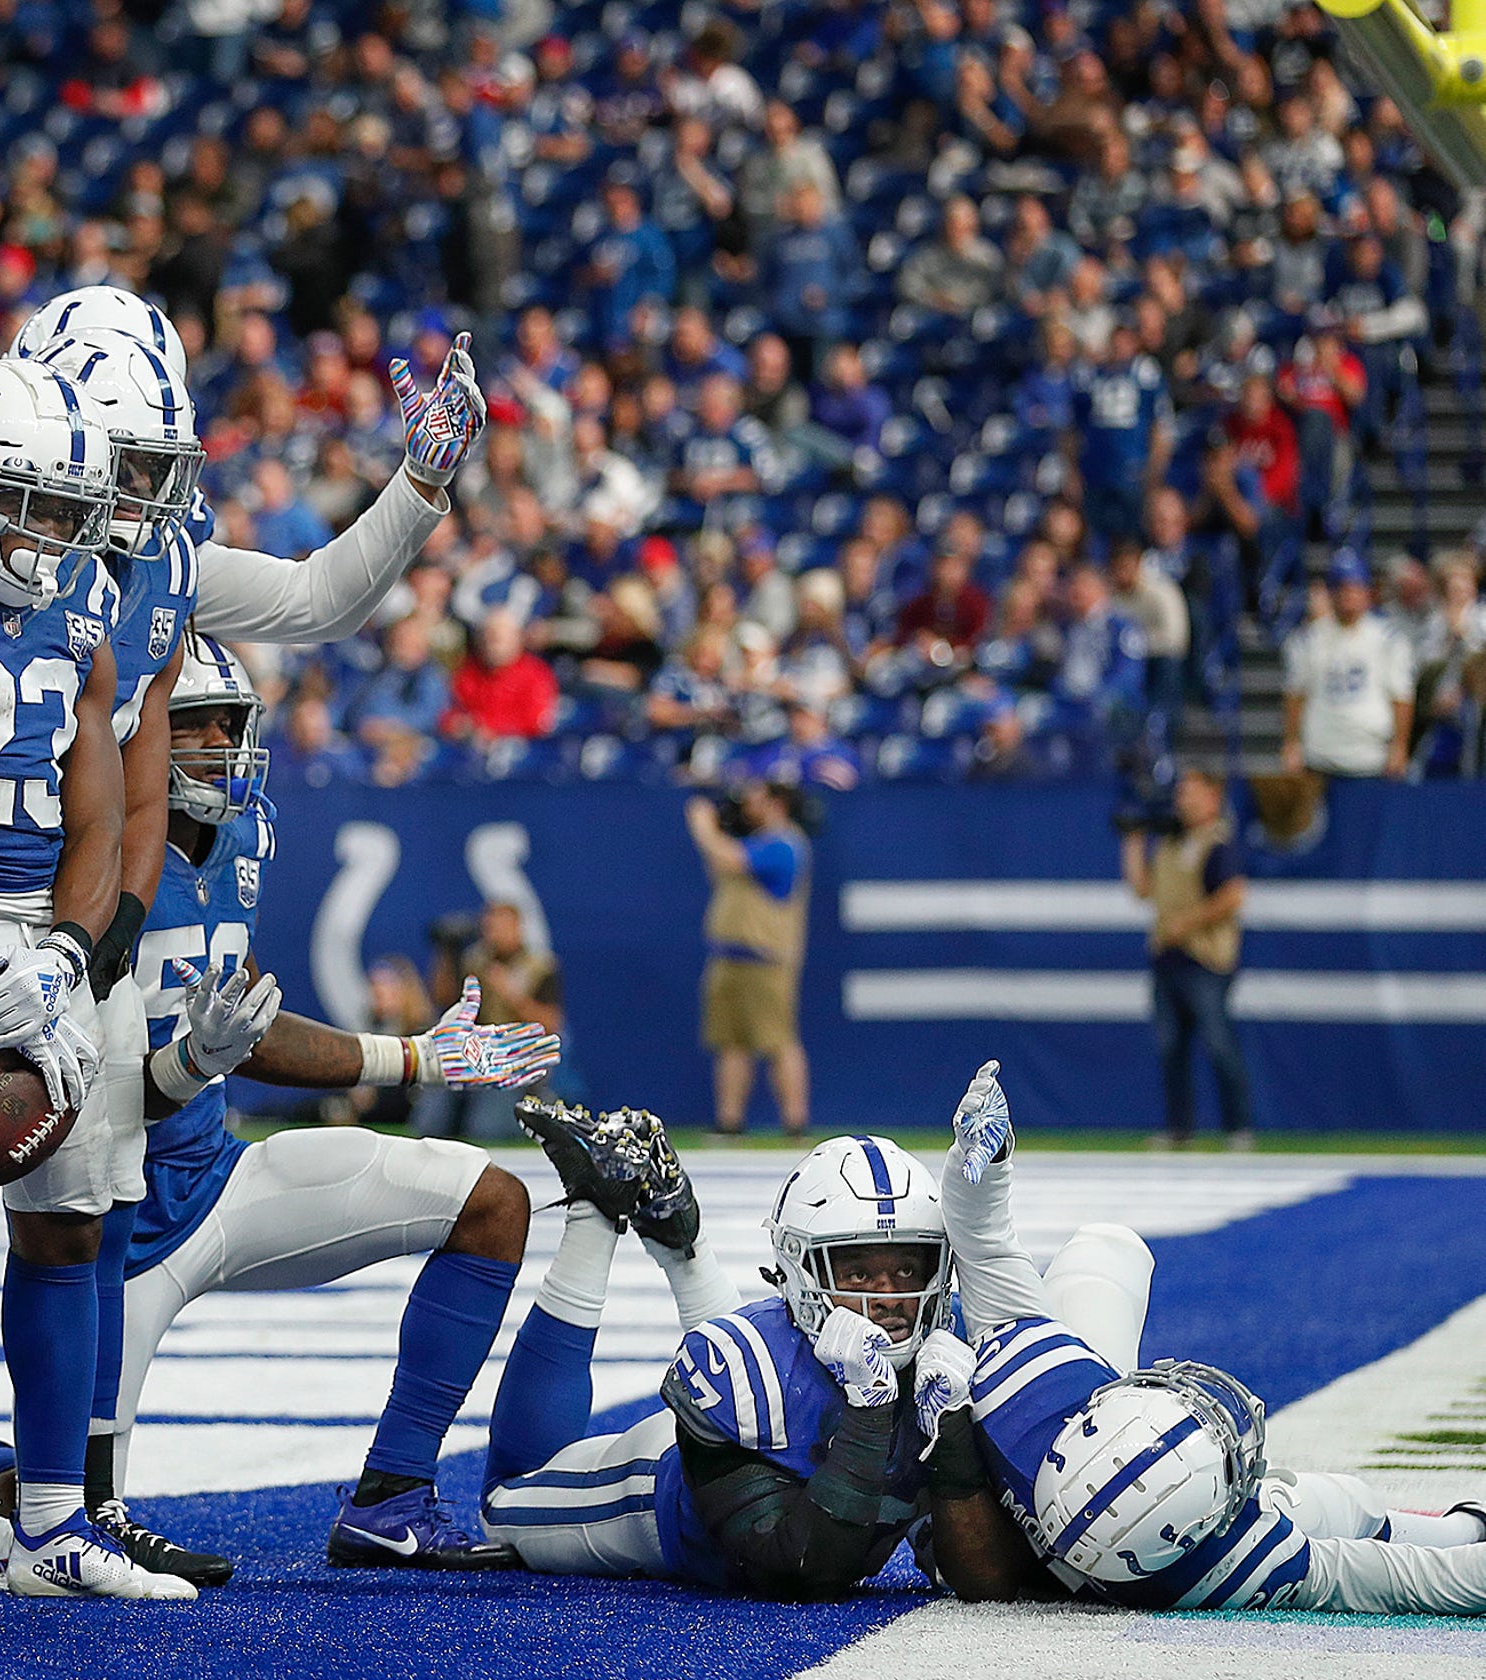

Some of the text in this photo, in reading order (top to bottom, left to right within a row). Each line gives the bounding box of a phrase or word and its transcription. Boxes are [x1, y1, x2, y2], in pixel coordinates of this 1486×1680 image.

[429, 408, 452, 440] NFL
[68, 611, 104, 648] 35
[152, 610, 175, 640] 35
